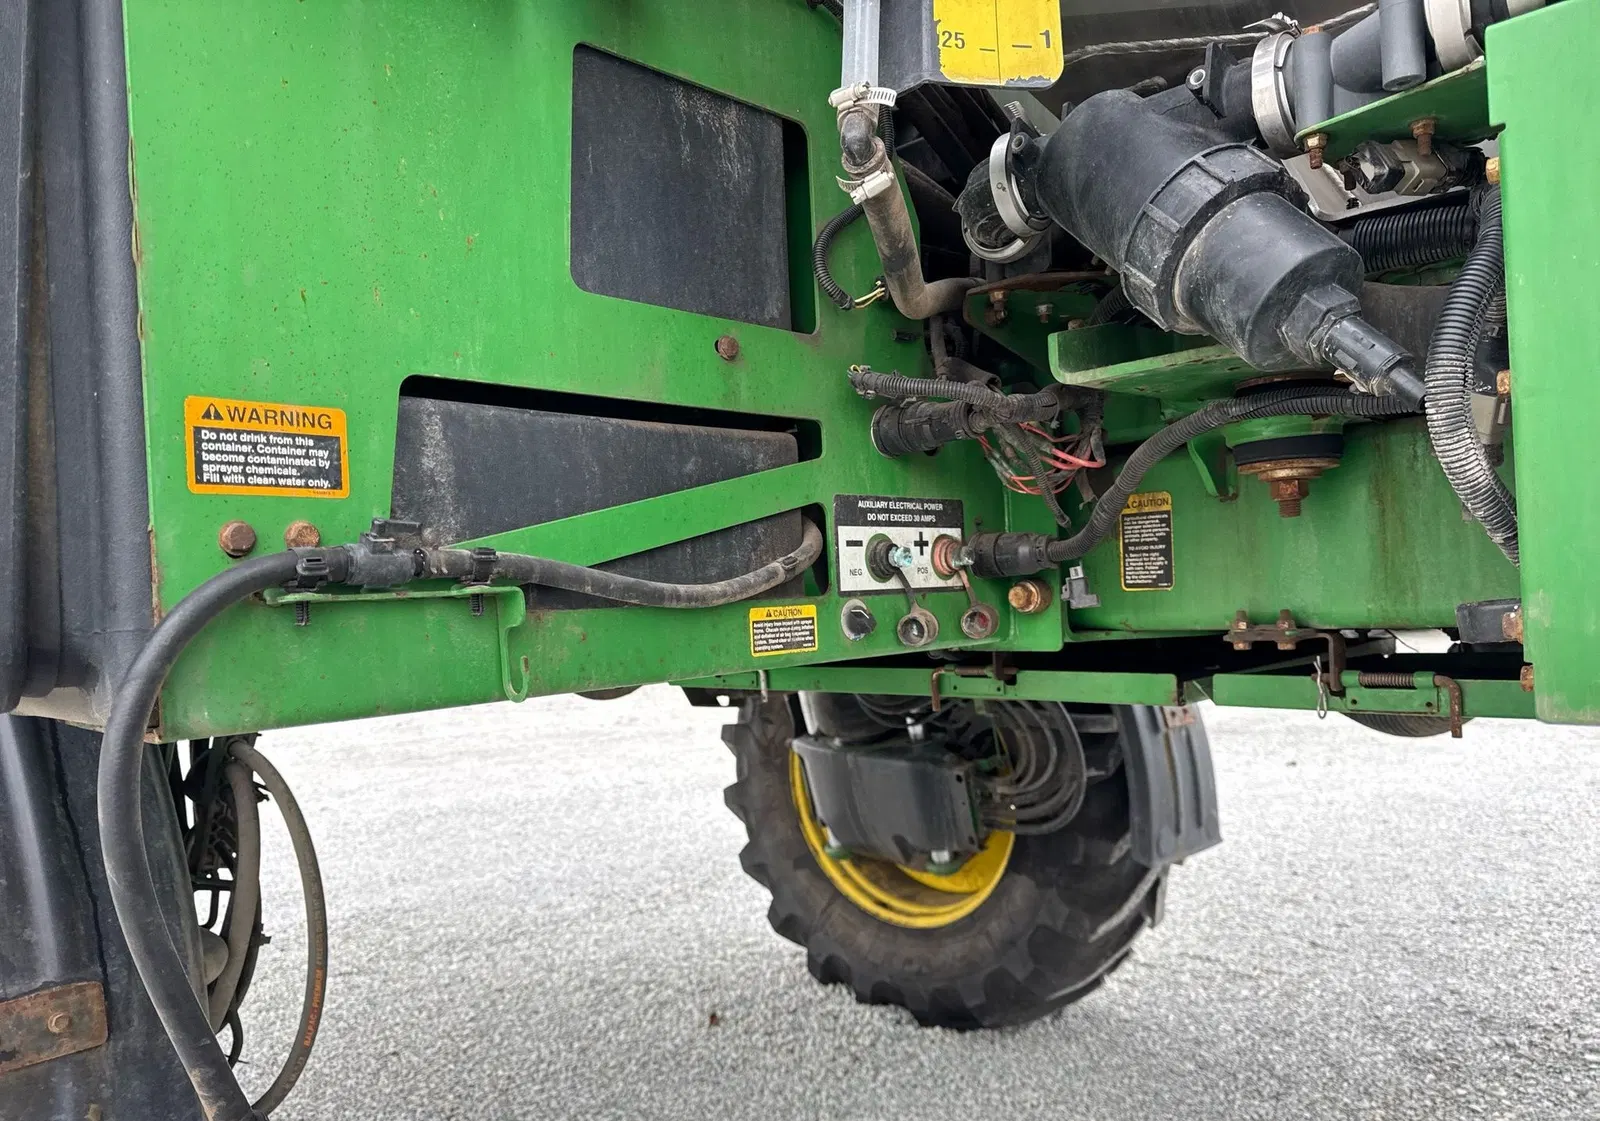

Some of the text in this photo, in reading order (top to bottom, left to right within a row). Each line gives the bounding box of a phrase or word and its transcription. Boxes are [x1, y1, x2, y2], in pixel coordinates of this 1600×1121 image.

[1040, 30, 1050, 48] 1
[226, 406, 332, 430] WARNING
[202, 430, 313, 446] Do not drink from this
[202, 443, 254, 453] container.
[257, 446, 306, 455] Container
[202, 452, 330, 469] become contaminated by
[203, 464, 300, 476] sprayer chemicals.
[203, 473, 330, 488] Fill with clean water only.
[858, 500, 887, 508] AUXILIARY
[889, 501, 922, 510] ELECTRICAL
[1132, 498, 1168, 508] CAUTION
[773, 608, 802, 617] CAUTION
[312, 968, 324, 1008] PREMIUM
